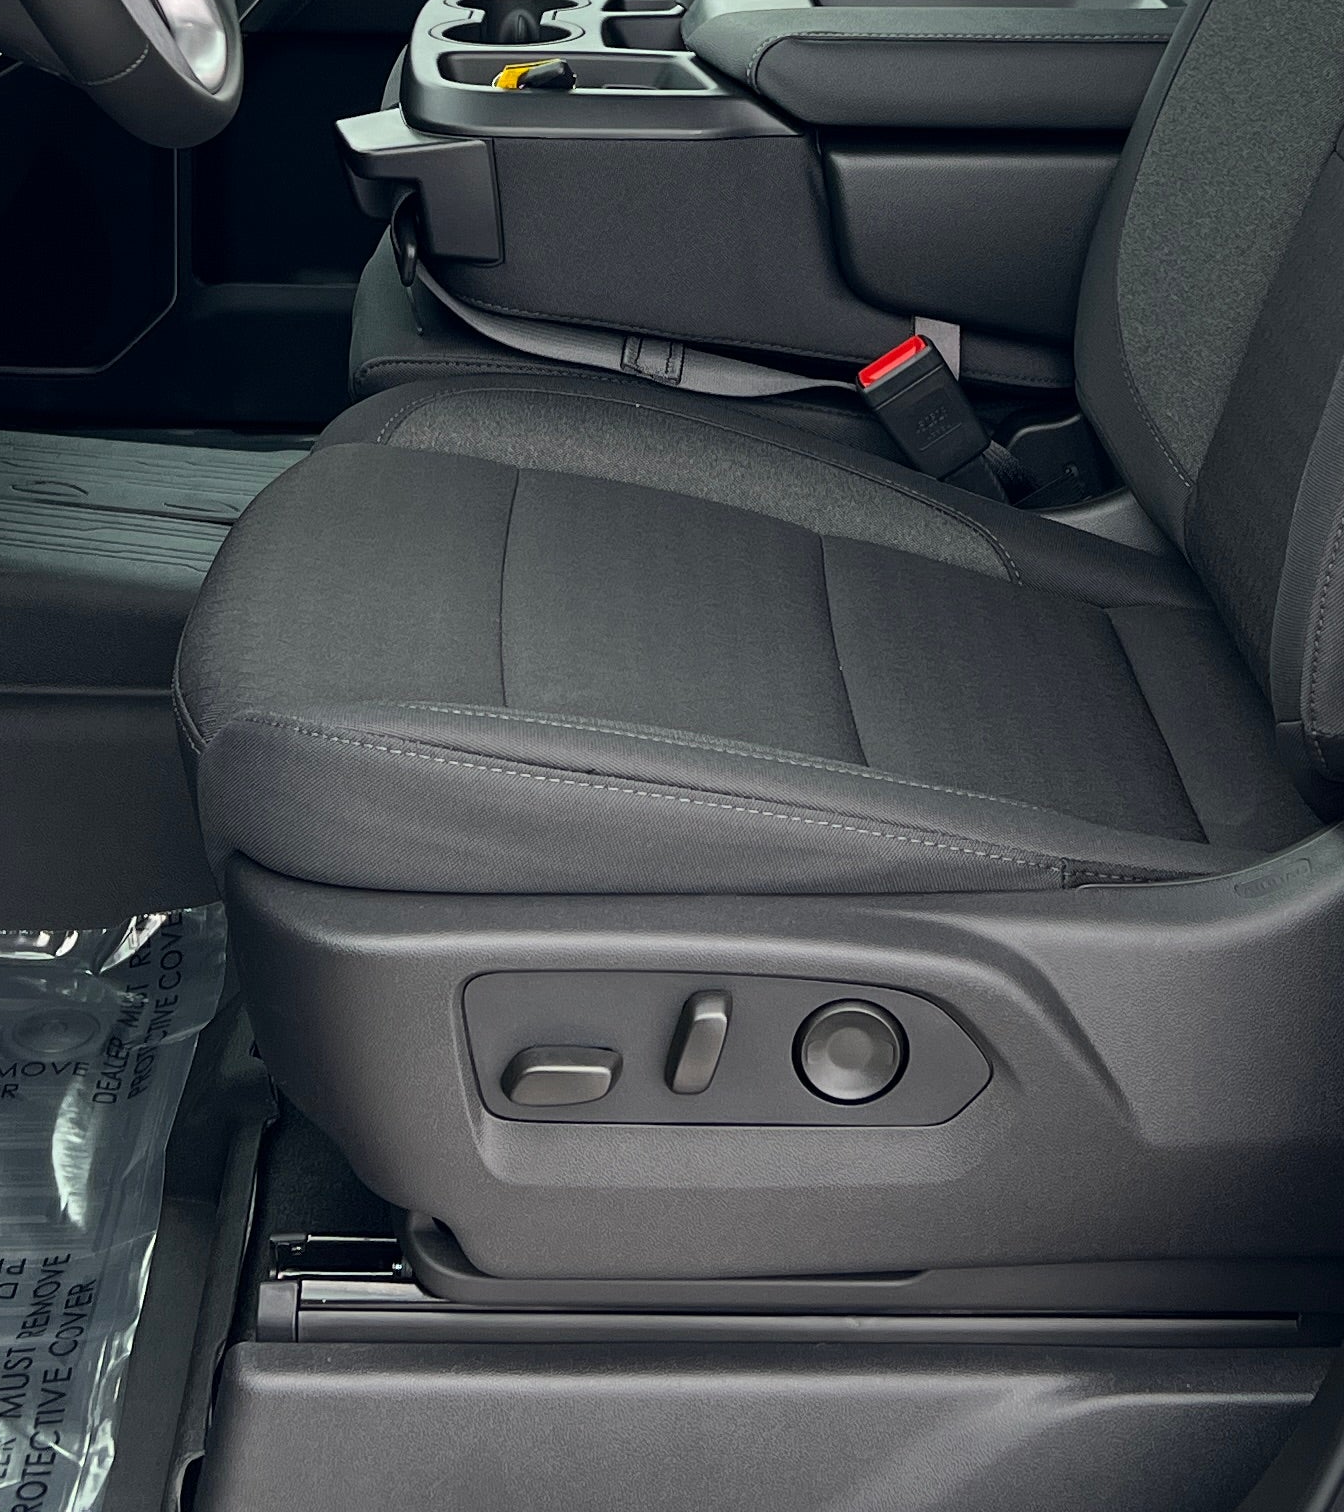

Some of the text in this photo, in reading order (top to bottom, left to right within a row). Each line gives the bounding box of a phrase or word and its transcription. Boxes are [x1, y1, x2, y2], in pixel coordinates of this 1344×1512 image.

[91, 1037, 127, 1105] DEALER
[17, 1253, 73, 1343] REMOVE
[49, 1279, 99, 1368] COVER
